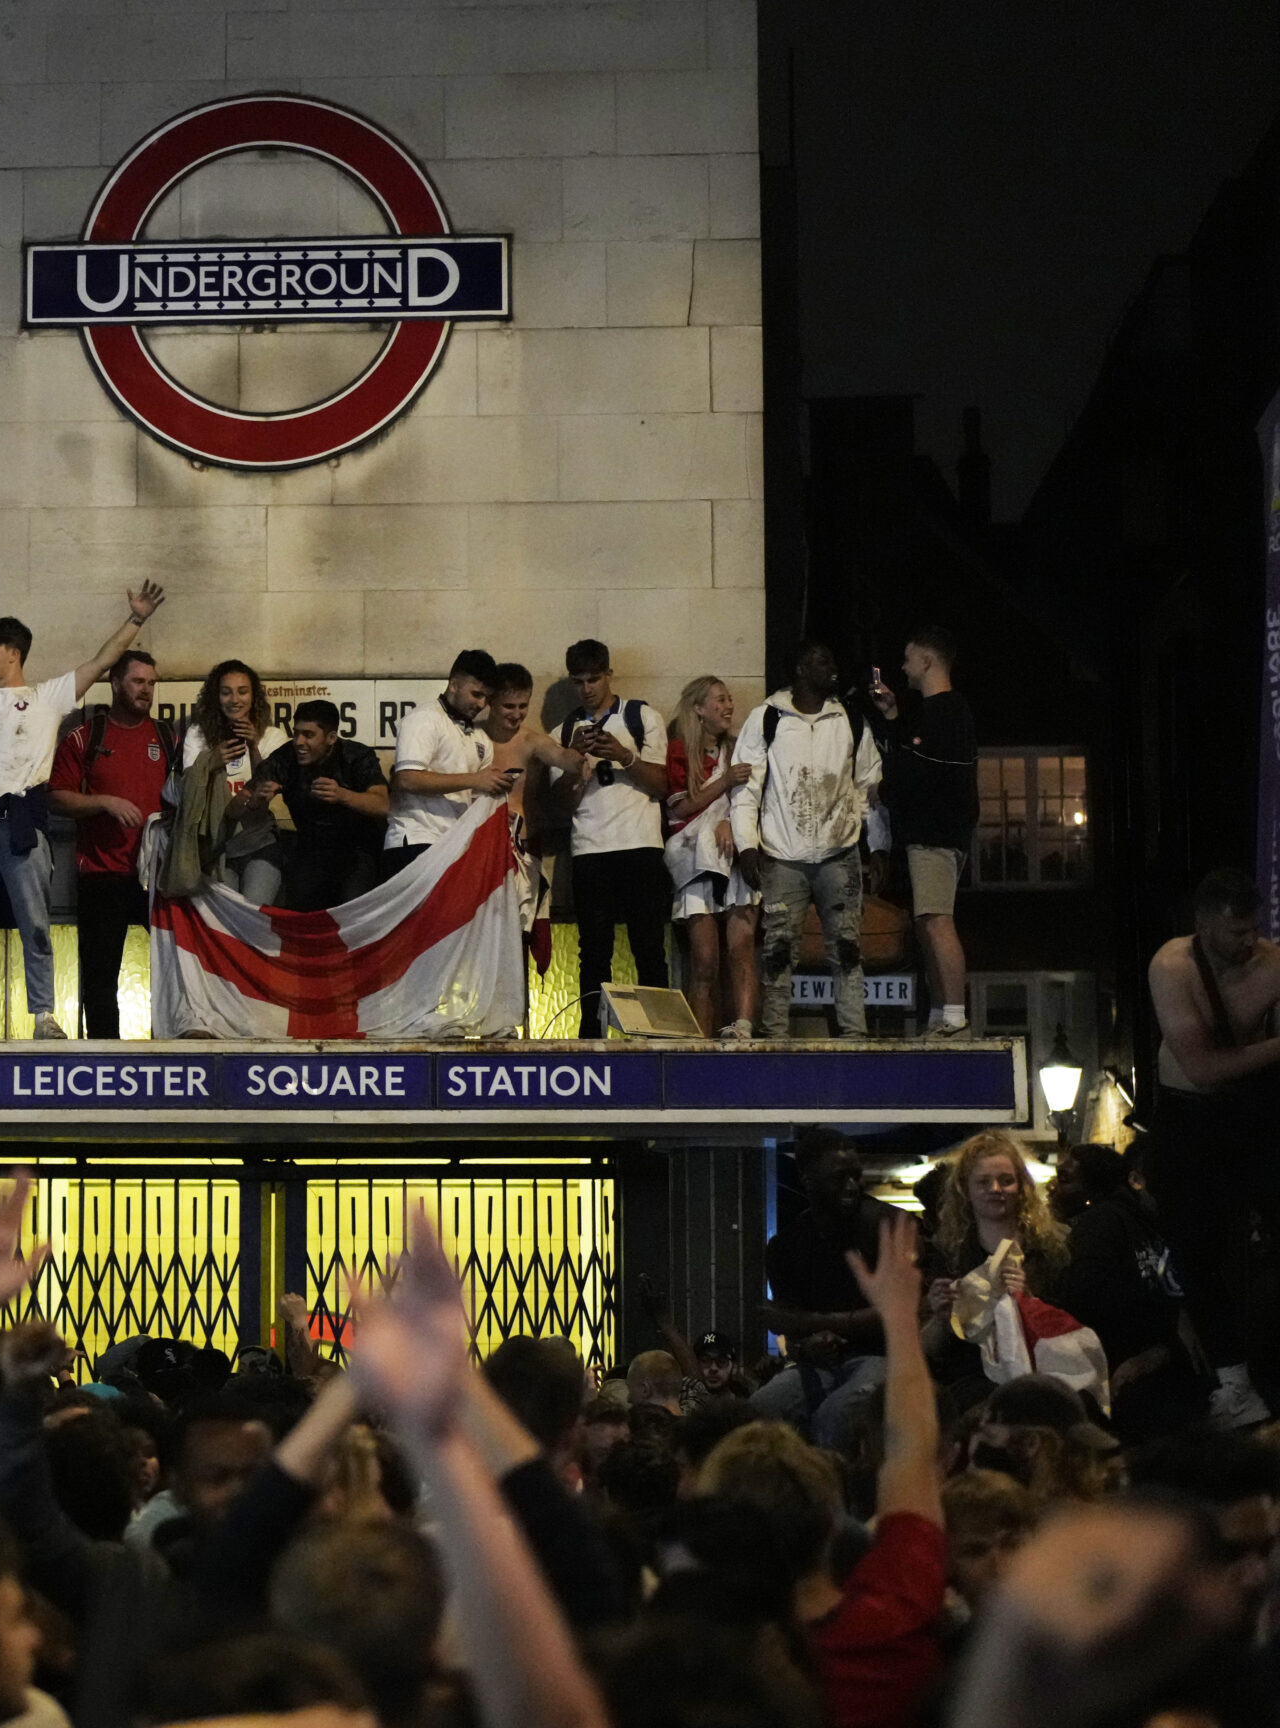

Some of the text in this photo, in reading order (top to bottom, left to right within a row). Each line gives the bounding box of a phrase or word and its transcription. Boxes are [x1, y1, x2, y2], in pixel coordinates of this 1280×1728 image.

[76, 247, 461, 313] UNDERGROUND
[13, 1065, 612, 1097] LEICESTER SQUARE STATION
